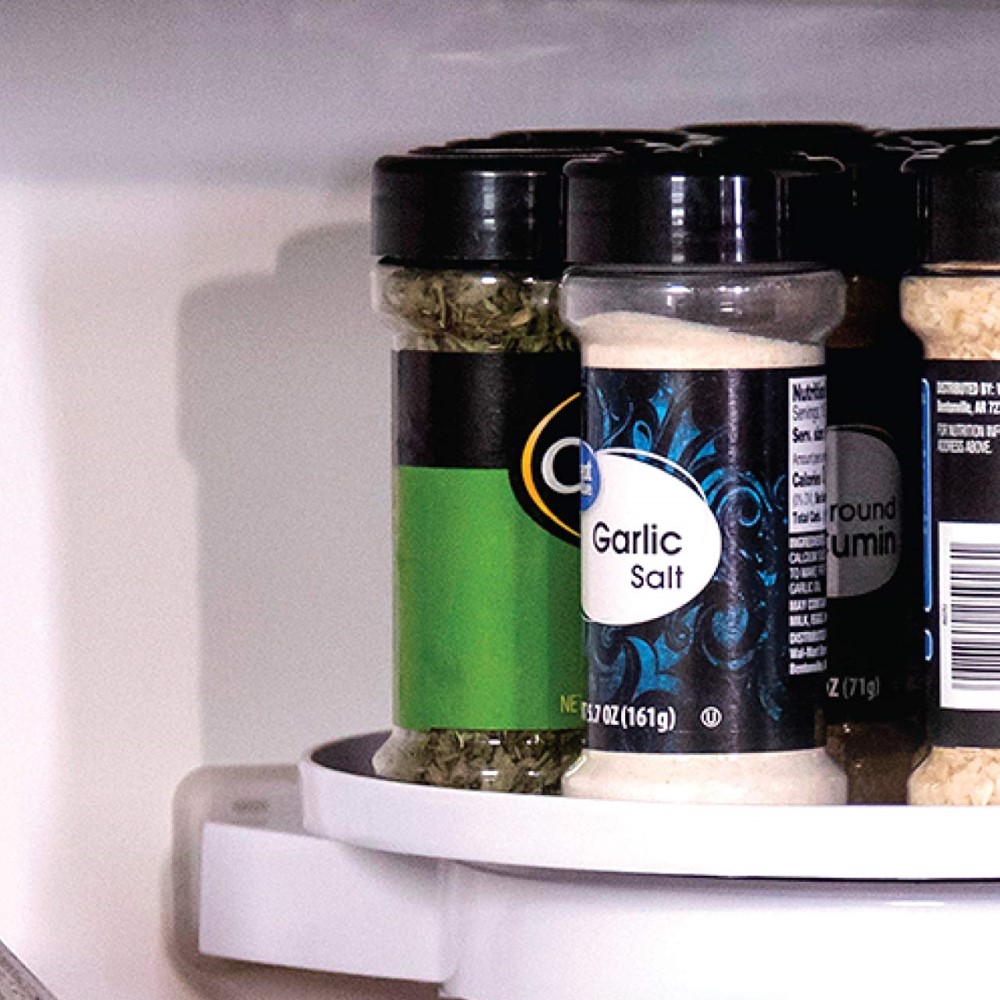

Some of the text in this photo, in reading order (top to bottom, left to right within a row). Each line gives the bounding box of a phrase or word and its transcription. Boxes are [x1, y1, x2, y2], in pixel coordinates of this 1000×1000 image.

[829, 495, 896, 522] round
[592, 520, 683, 556] Garlic
[830, 525, 896, 558] umin
[631, 564, 683, 589] Salt
[560, 694, 578, 714] NE
[602, 705, 676, 734] OZ (161g)
